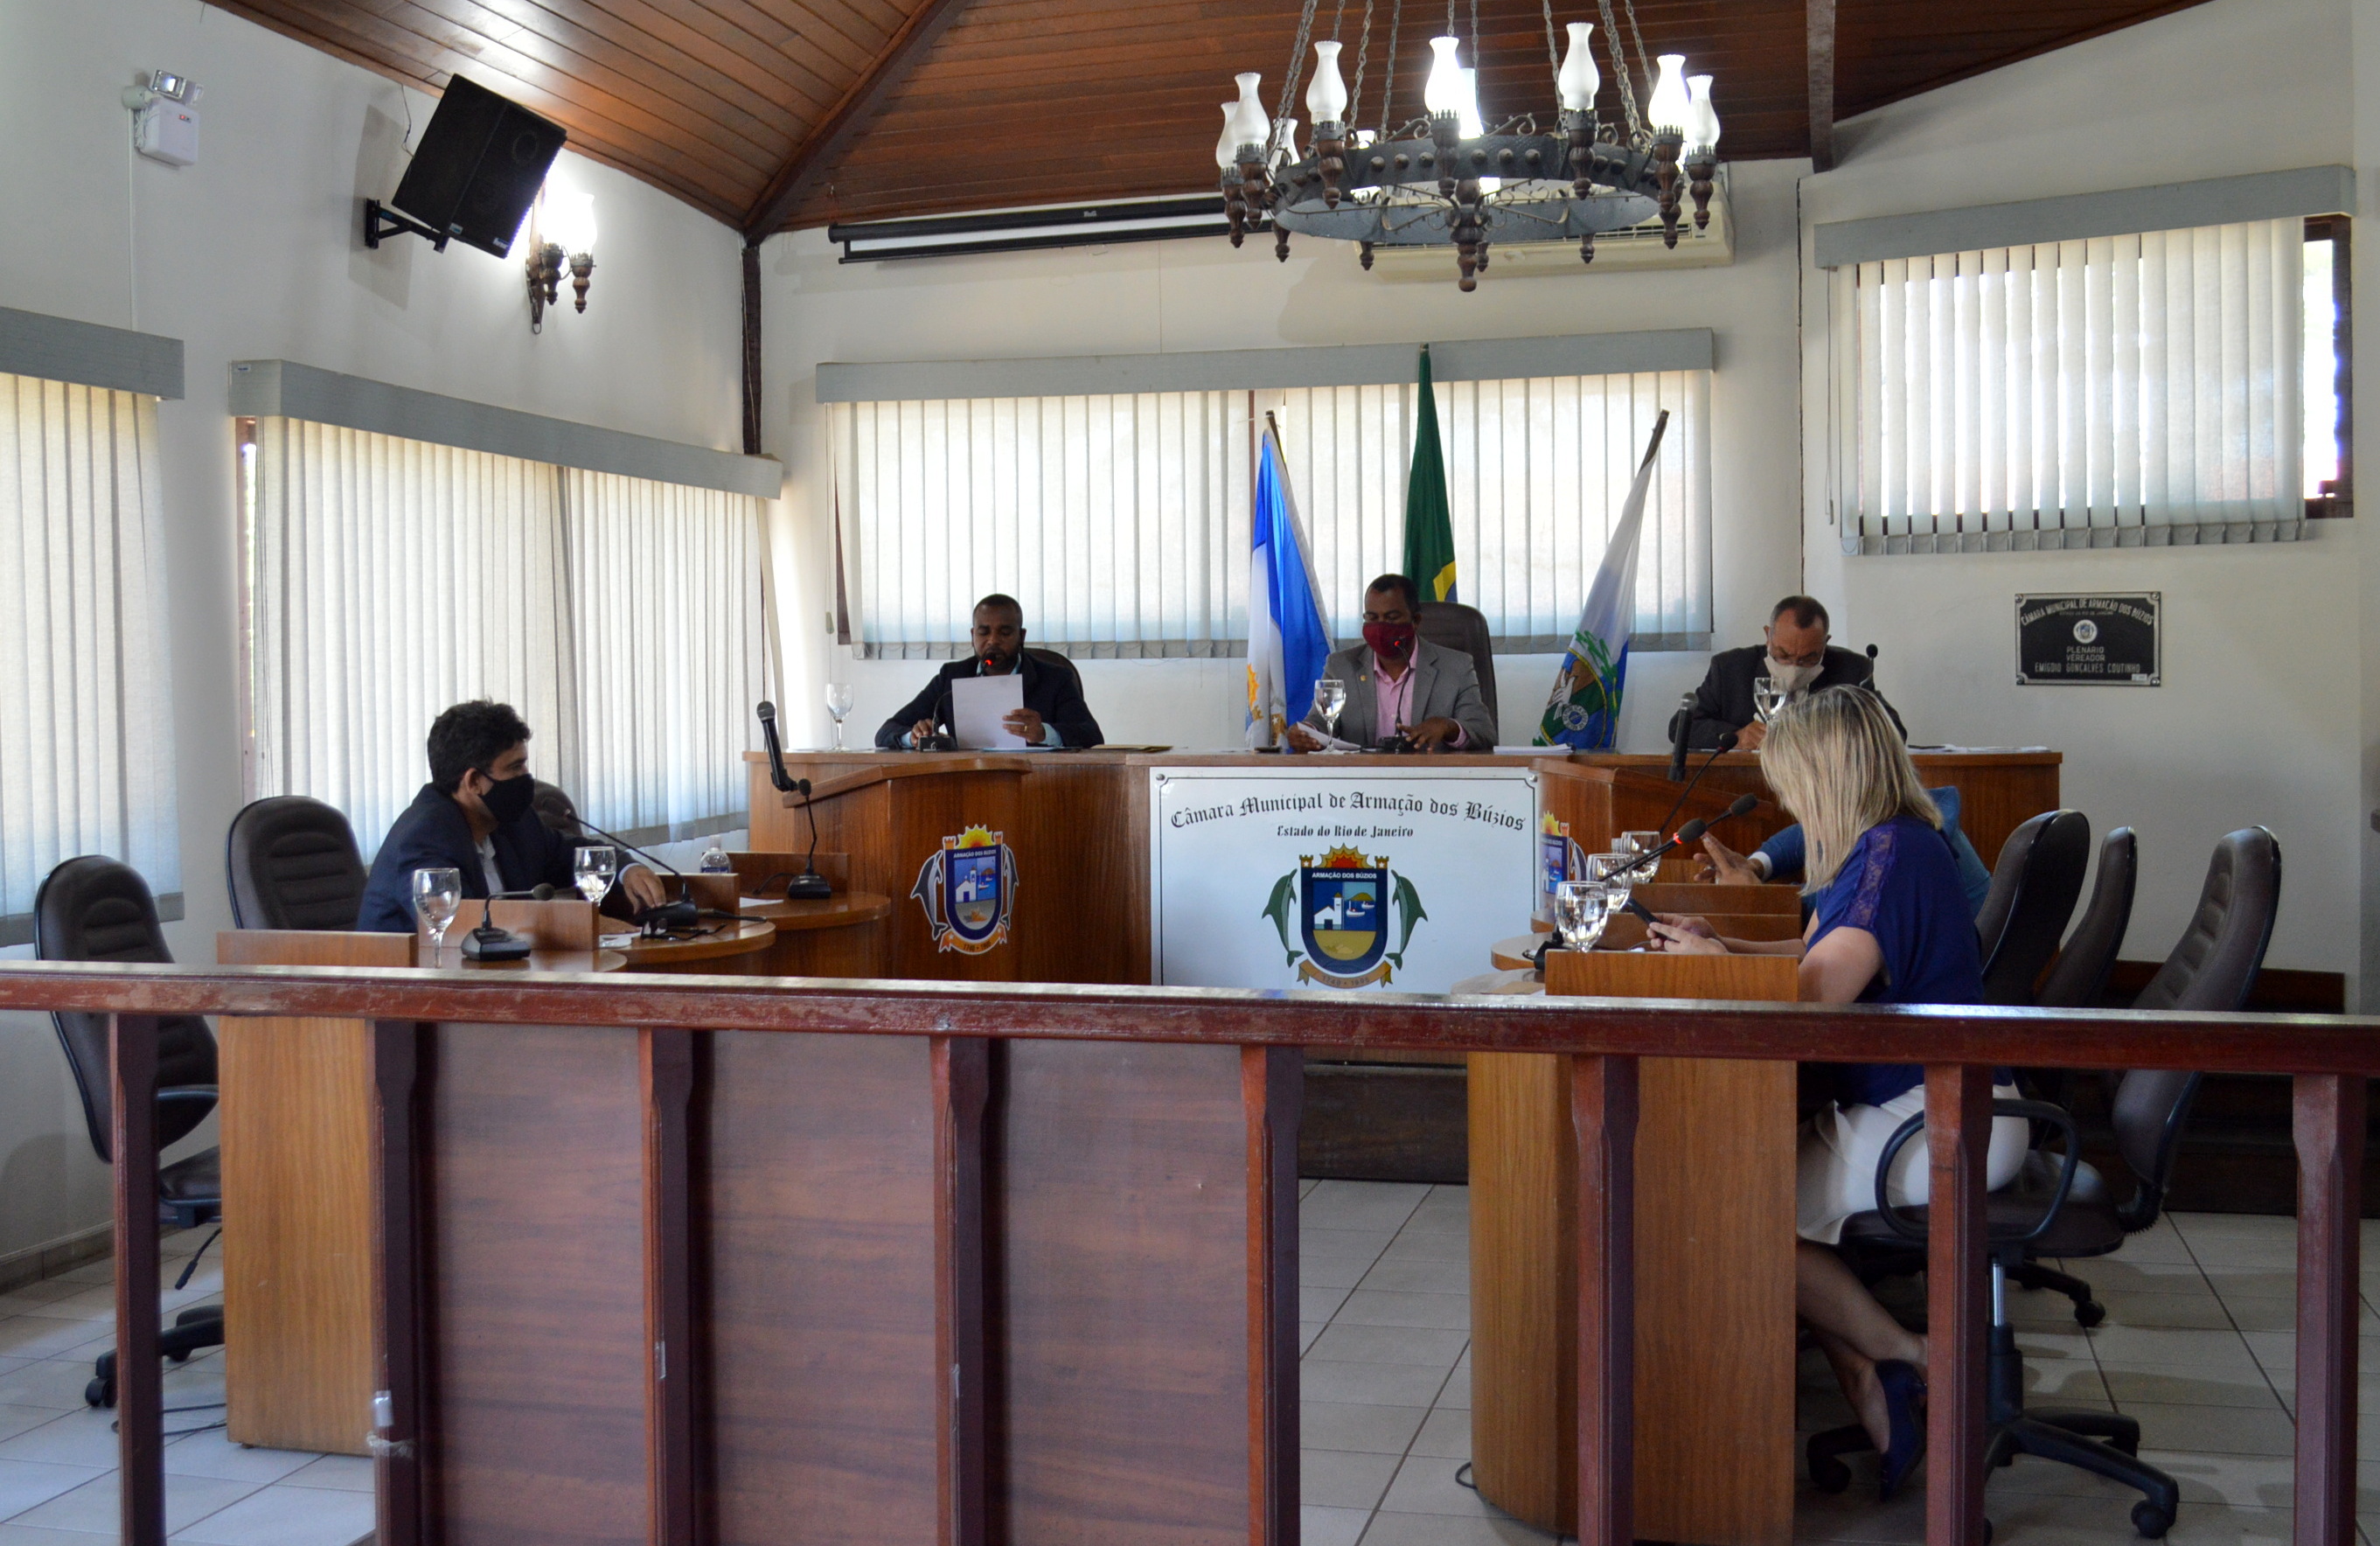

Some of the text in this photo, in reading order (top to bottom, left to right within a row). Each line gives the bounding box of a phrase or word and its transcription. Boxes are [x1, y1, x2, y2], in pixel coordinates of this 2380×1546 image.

[2079, 598, 2088, 609] DE
[2119, 602, 2133, 616] DOS
[2066, 663, 2104, 674] GONÇALVES
[2107, 663, 2140, 673] COUTINHO
[1171, 791, 1526, 832] Câmara Municipal de Armação dos Búzios
[1277, 825, 1314, 838] Estado
[1317, 825, 1331, 838] do
[1370, 825, 1414, 839] Janeiro
